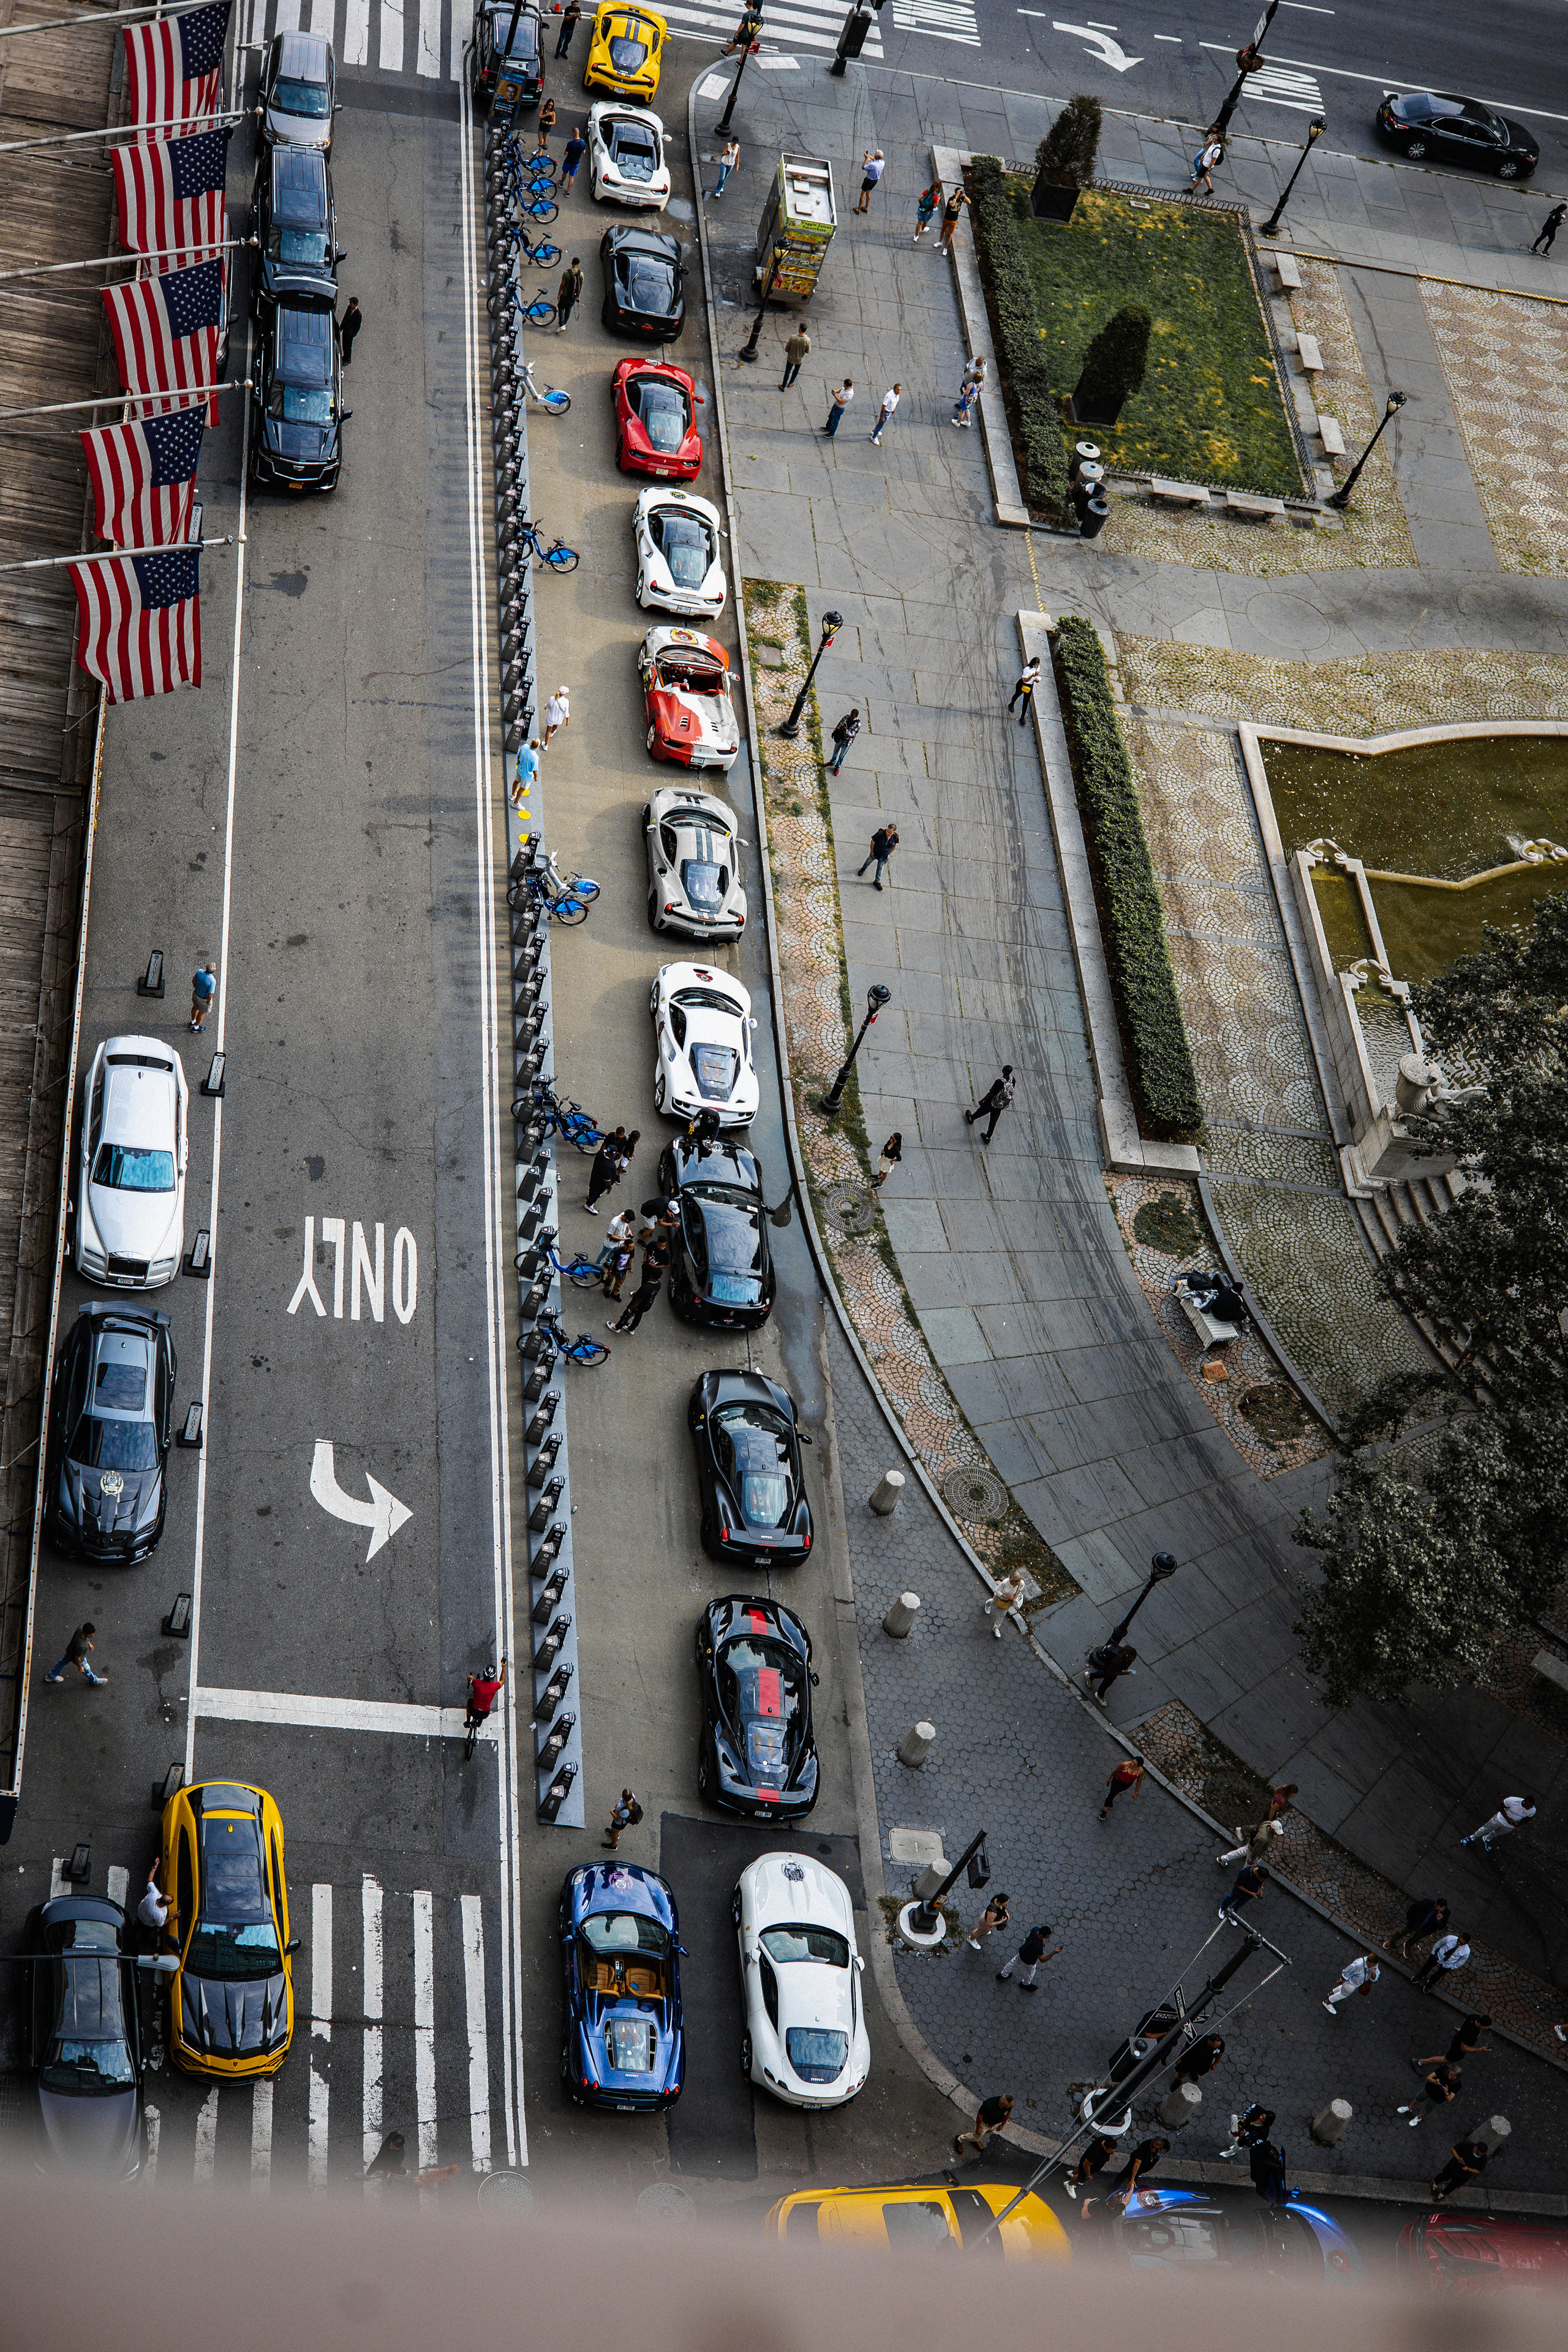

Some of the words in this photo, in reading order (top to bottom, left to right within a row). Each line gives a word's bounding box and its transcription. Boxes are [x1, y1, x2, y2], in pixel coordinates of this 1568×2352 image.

[892, 0, 981, 47] ONLY
[1237, 64, 1325, 115] ONLY
[287, 1216, 417, 1324] ONLY
